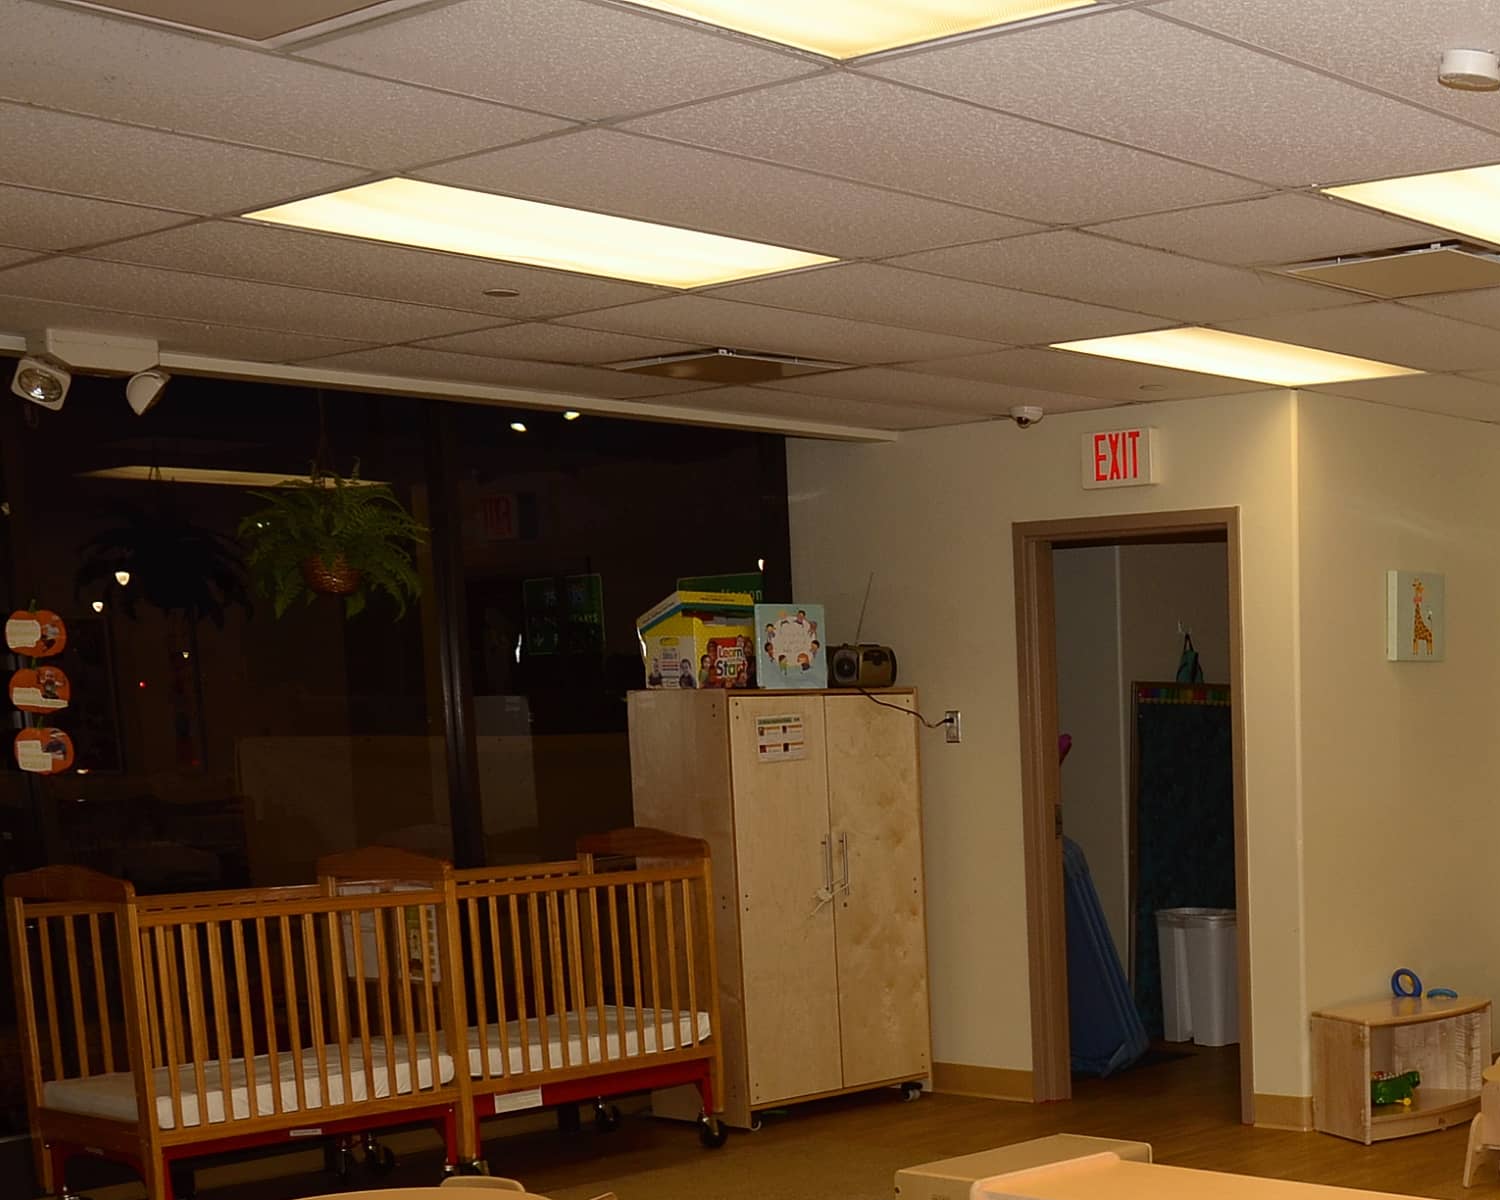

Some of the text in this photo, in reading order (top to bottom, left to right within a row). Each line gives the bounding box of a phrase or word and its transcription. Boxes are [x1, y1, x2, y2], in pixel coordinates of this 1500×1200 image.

[1094, 431, 1140, 481] EXIT
[718, 647, 743, 658] Learn
[716, 660, 747, 676] Start
